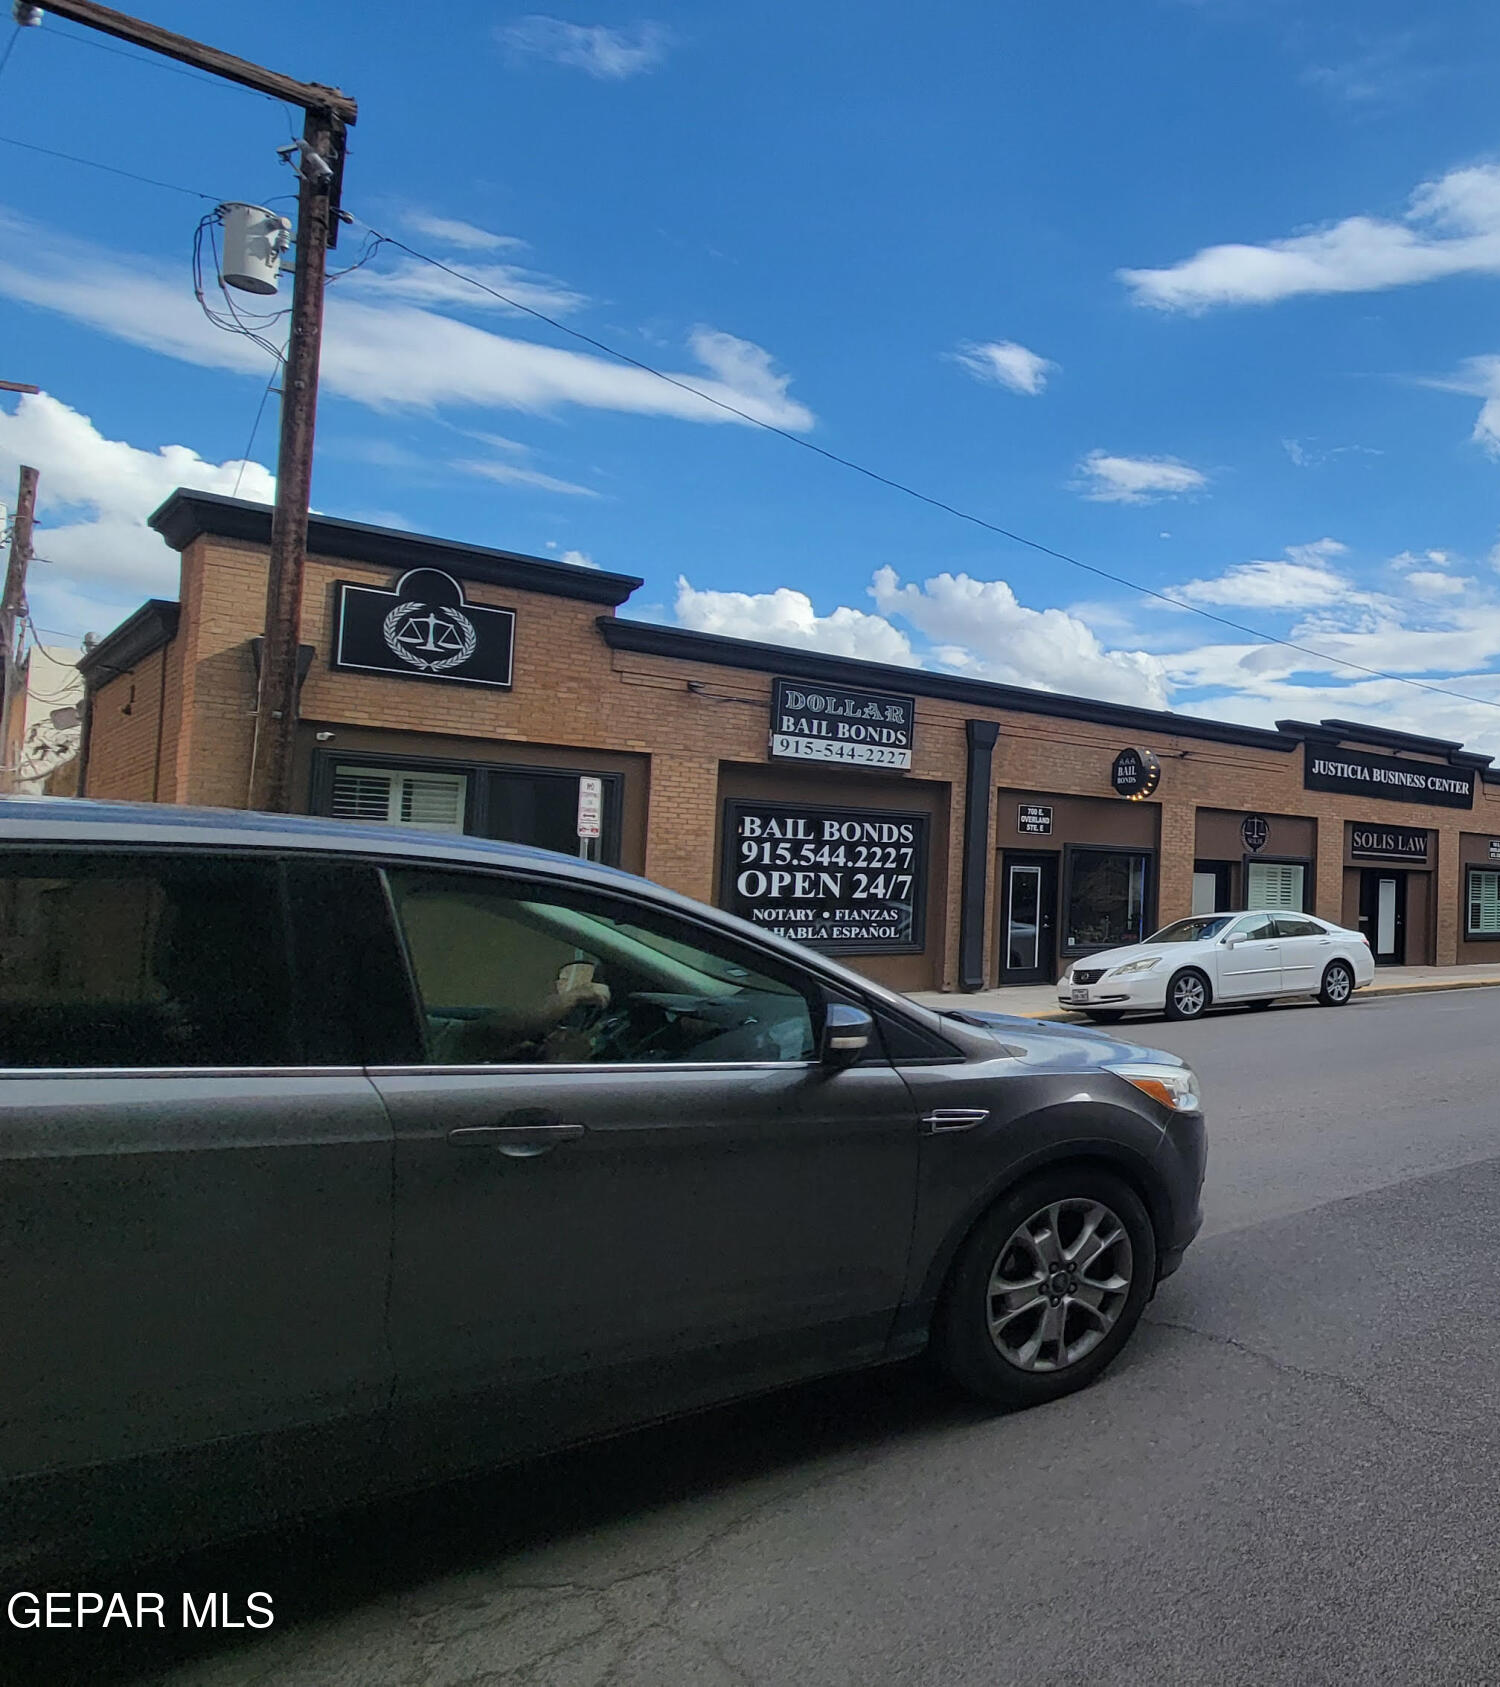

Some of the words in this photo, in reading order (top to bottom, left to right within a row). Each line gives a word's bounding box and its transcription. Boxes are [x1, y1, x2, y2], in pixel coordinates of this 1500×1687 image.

[785, 690, 905, 724] DOLLAR
[781, 715, 832, 737] BAIL
[837, 722, 907, 746] BONDS
[779, 738, 907, 765] 915-544-2227
[1117, 766, 1137, 777] BAIL
[1117, 776, 1137, 784] BONDS
[1312, 759, 1370, 781] JUSTICIA
[1372, 768, 1426, 789] BUSINESS
[1427, 777, 1470, 795] CENTER
[741, 816, 815, 840] BAIL
[822, 820, 914, 843] BONDS
[1353, 831, 1395, 849] SOLIS
[1398, 836, 1428, 852] LAW
[741, 840, 913, 869] 915.544.2227
[737, 870, 844, 898] OPEN
[851, 873, 913, 900] 24/7
[752, 908, 816, 921] NOTARY
[835, 909, 898, 921] FIANZAS
[773, 926, 829, 939] HABLA
[832, 922, 899, 938] ESPAÑOL
